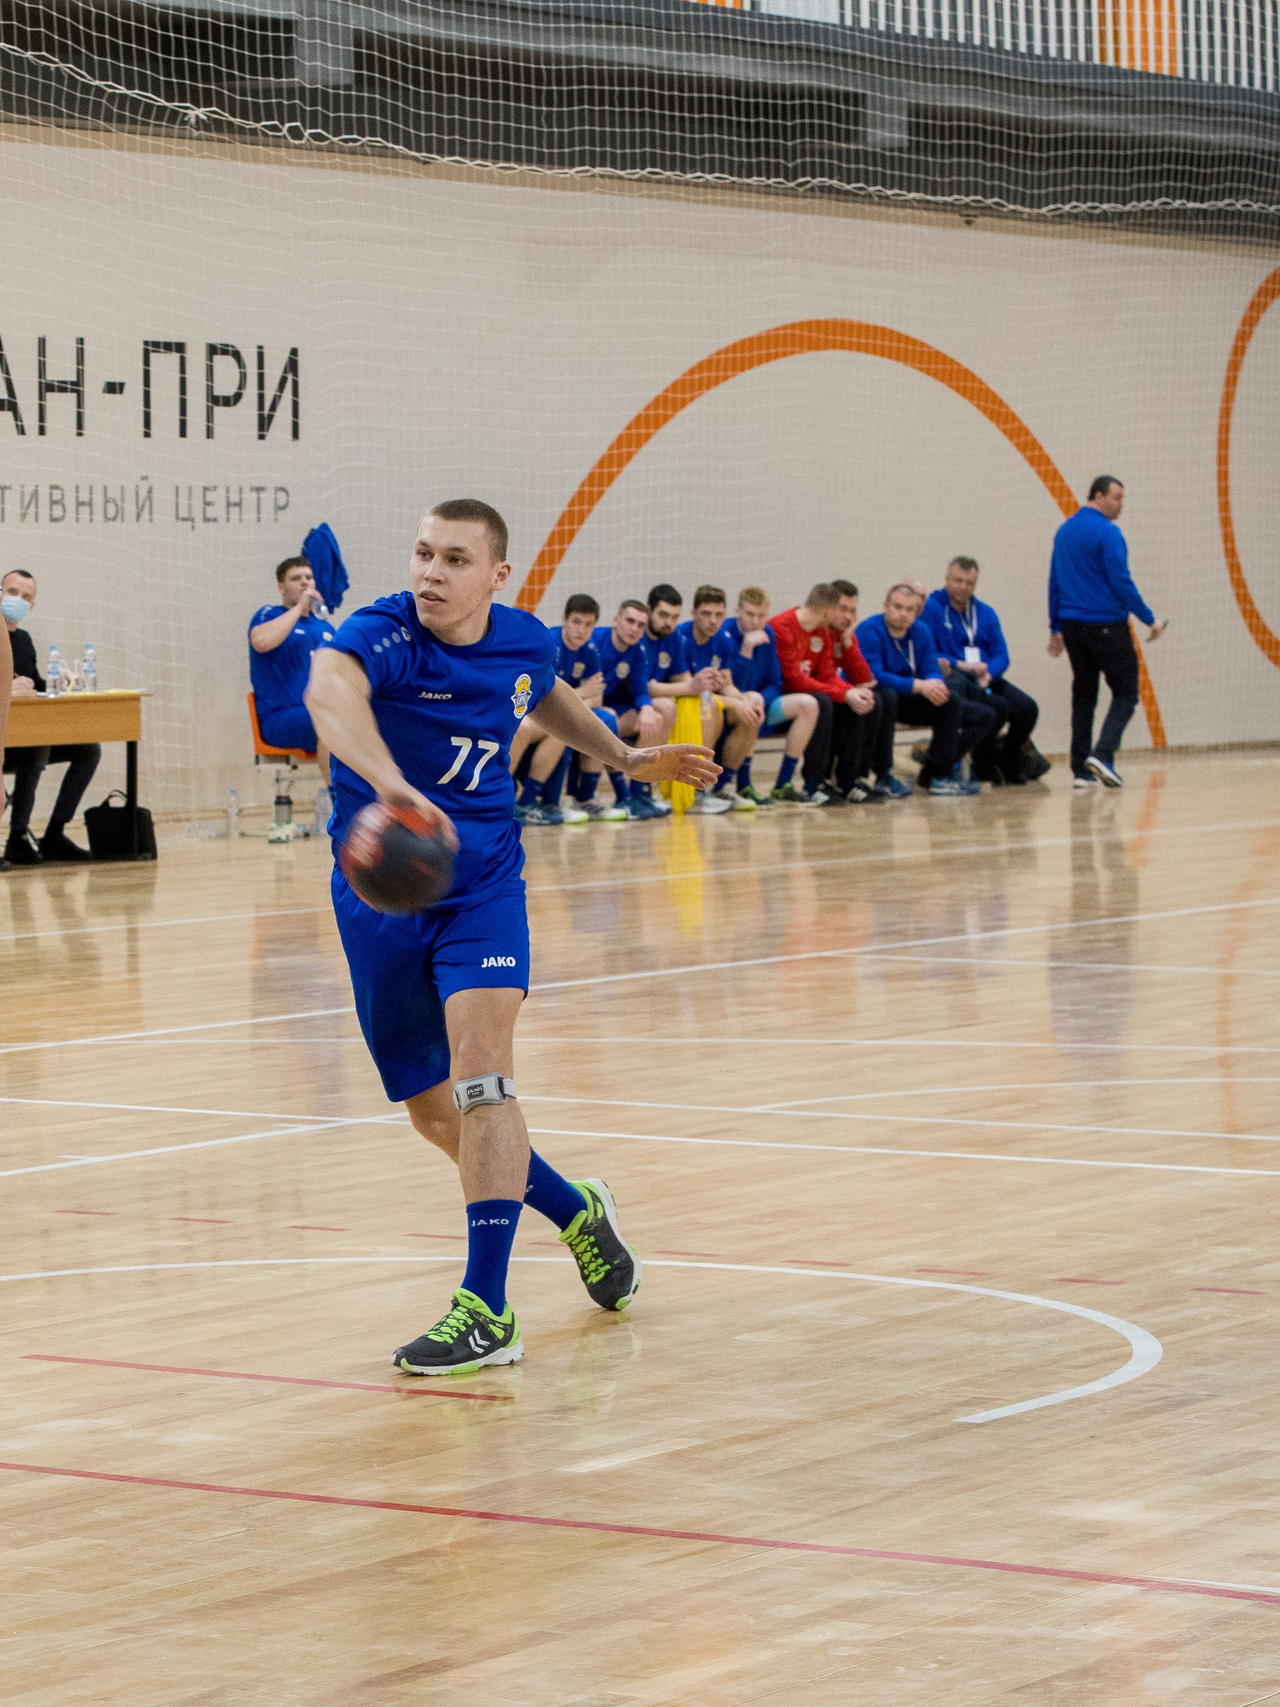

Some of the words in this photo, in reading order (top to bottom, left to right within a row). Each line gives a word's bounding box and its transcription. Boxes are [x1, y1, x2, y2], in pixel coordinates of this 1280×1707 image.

[175, 485, 290, 530] ЦЕНТР
[418, 691, 452, 700] JAKO
[436, 736, 499, 791] 77
[481, 956, 516, 968] JAKO
[471, 1218, 509, 1227] JAKO
